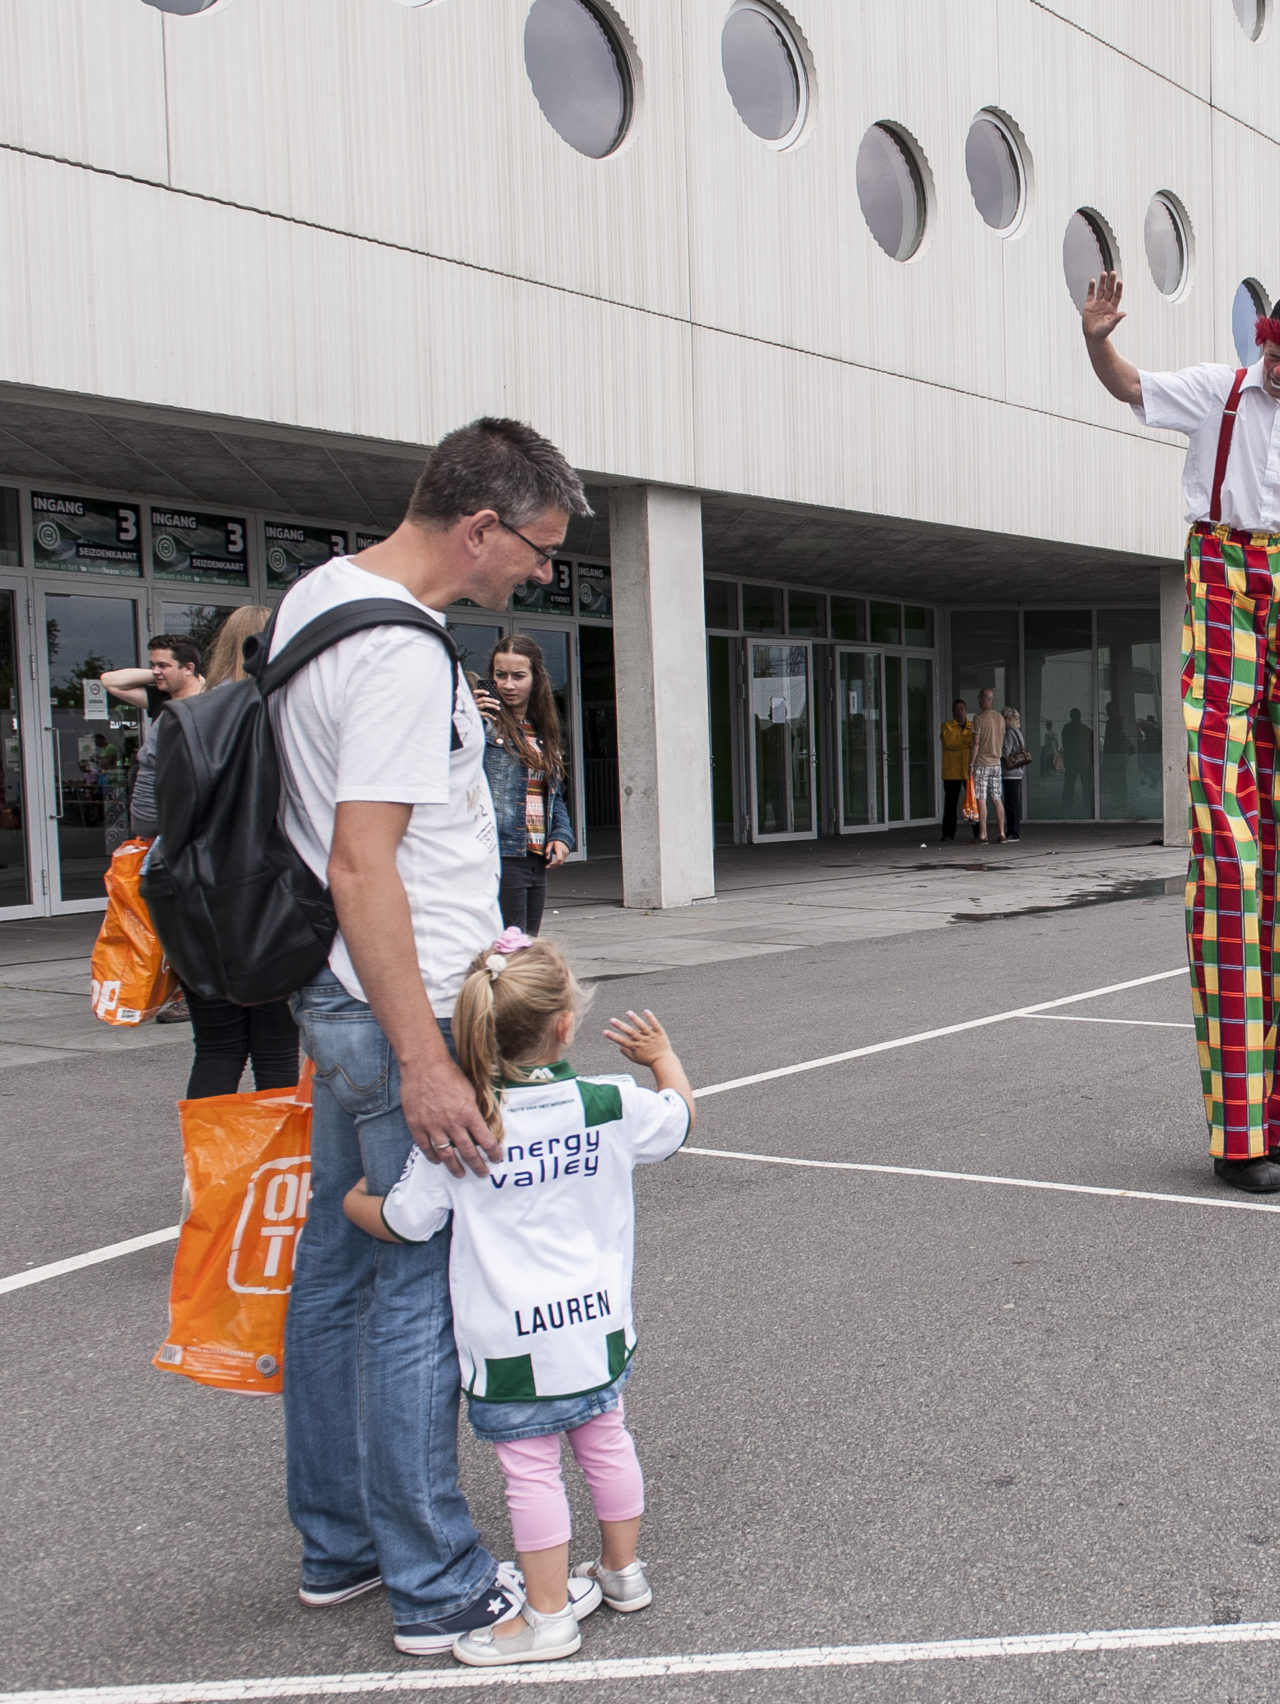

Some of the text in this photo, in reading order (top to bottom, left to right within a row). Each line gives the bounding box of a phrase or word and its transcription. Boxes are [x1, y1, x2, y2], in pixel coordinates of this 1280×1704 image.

[33, 497, 84, 515] INGANG
[118, 509, 137, 541] 3
[152, 512, 197, 529] INGANG
[228, 522, 244, 552] 3
[266, 526, 304, 541] INGANG
[79, 547, 137, 561] SEIZOENKAART
[192, 559, 245, 572] SEIZOENKAART
[578, 567, 604, 578] INGANG
[559, 565, 570, 588] 3
[501, 1130, 599, 1163] nergy
[490, 1155, 599, 1189] valley
[514, 1289, 612, 1337] LAUREN
